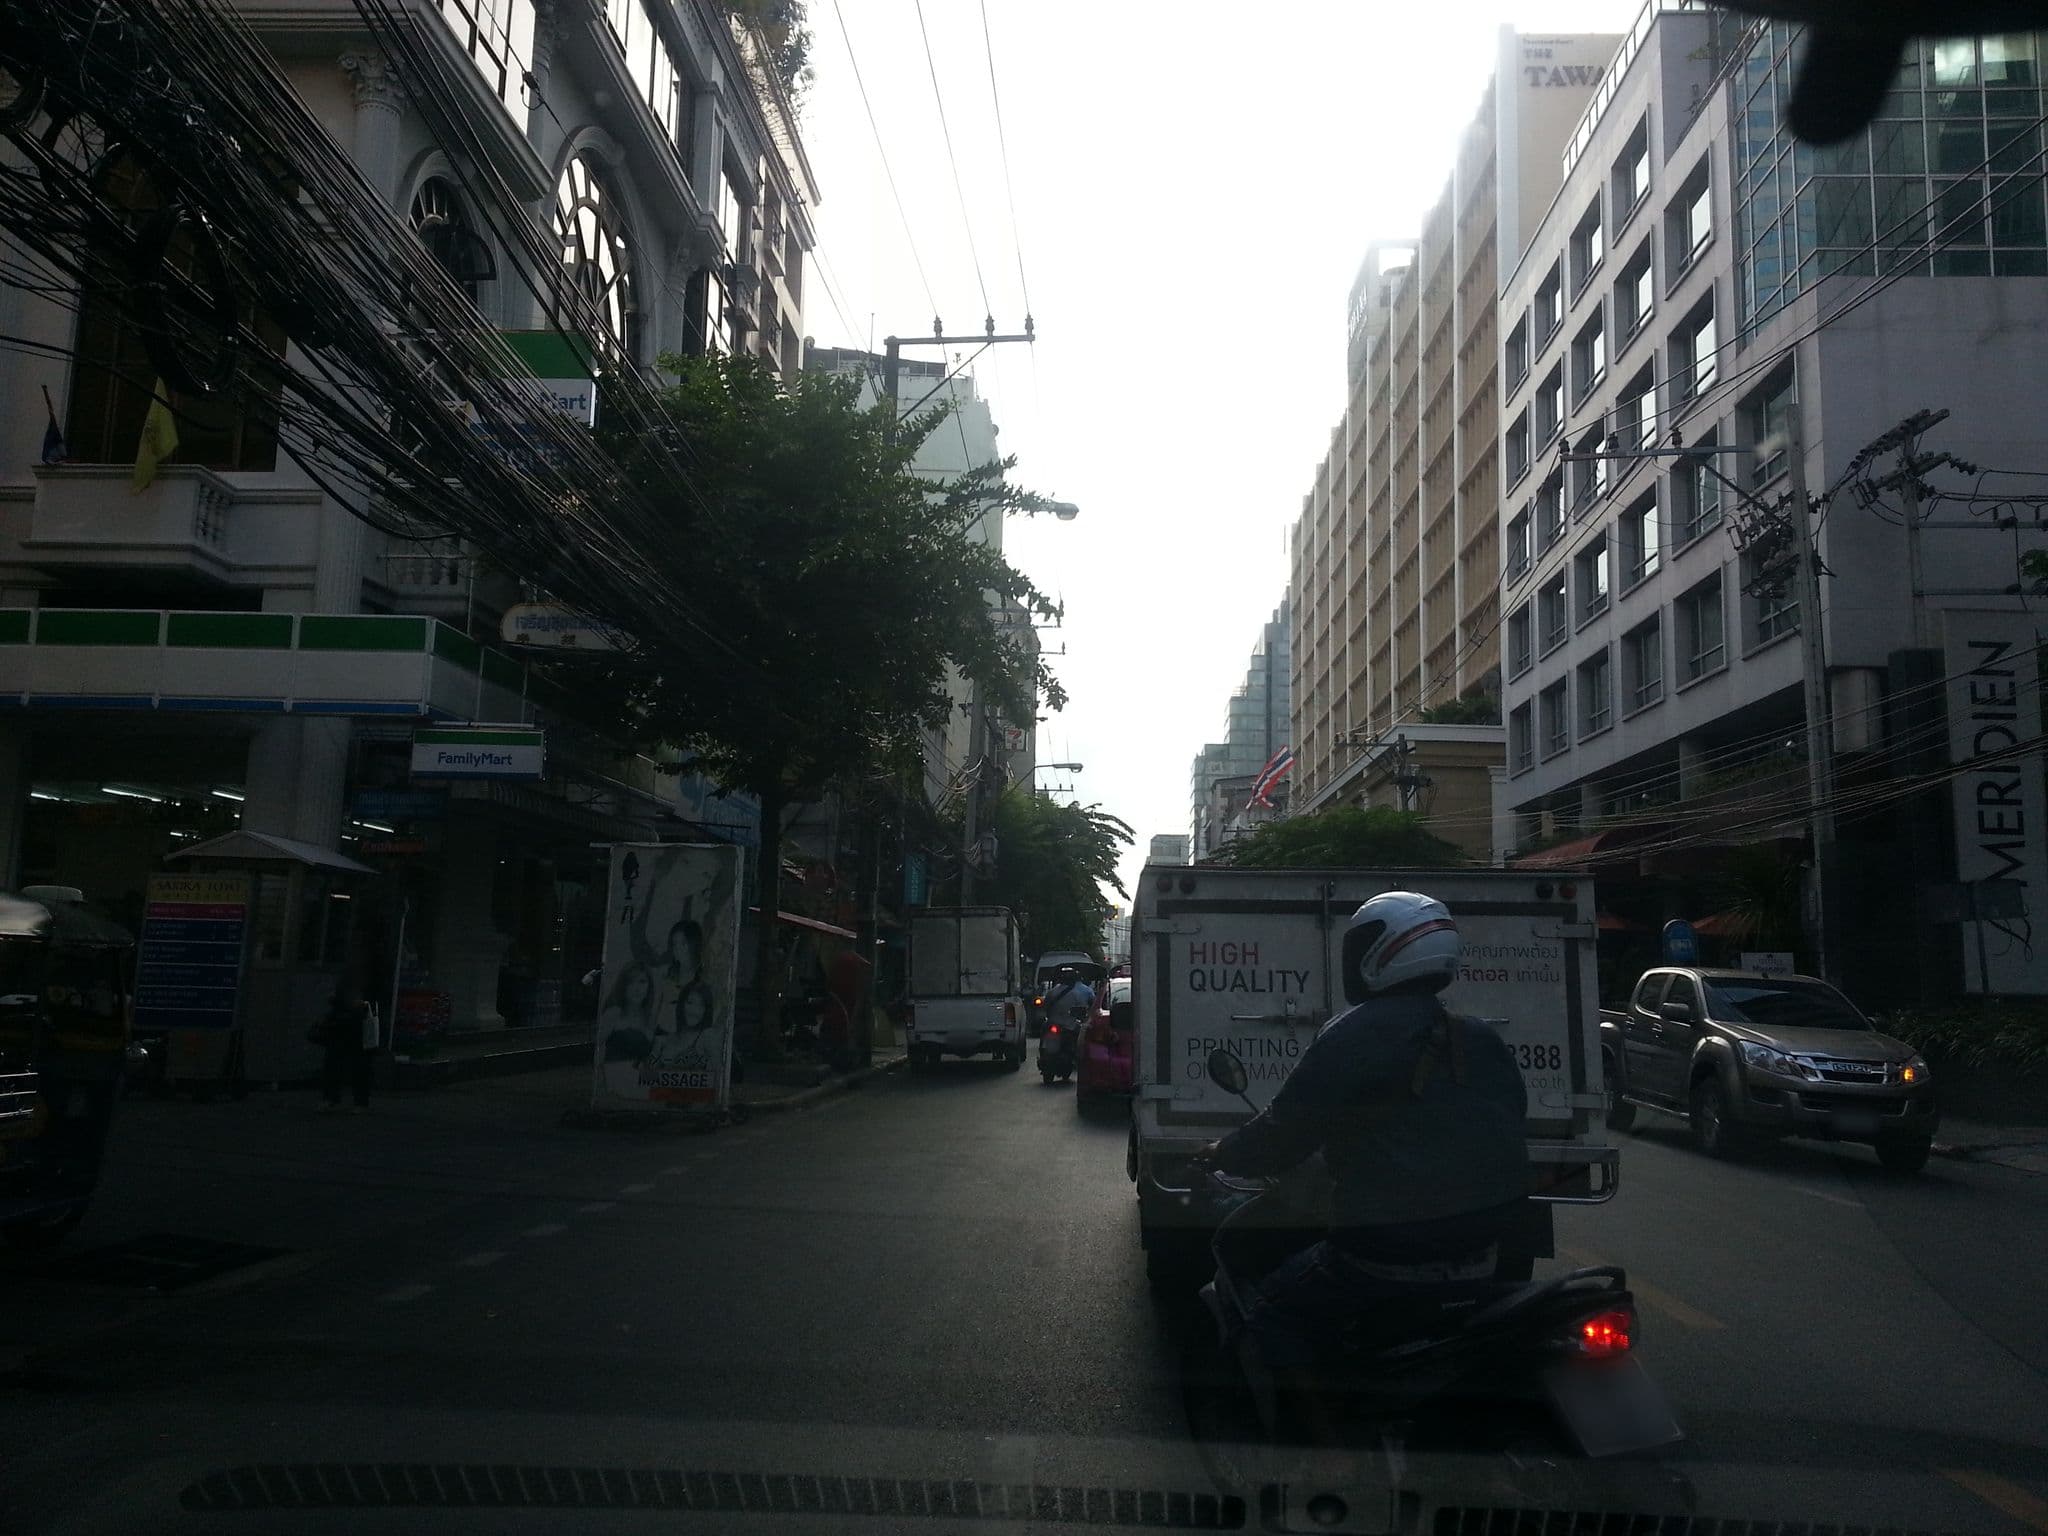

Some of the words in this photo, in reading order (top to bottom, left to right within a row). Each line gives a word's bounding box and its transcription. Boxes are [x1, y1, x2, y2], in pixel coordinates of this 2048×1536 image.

[438, 751, 513, 767] FamilyMart
[1968, 639, 2028, 888] MERIDIEN
[1189, 942, 1259, 965] HIGH
[1188, 968, 1311, 993] QUALITY
[1187, 1037, 1299, 1058] PRINTING
